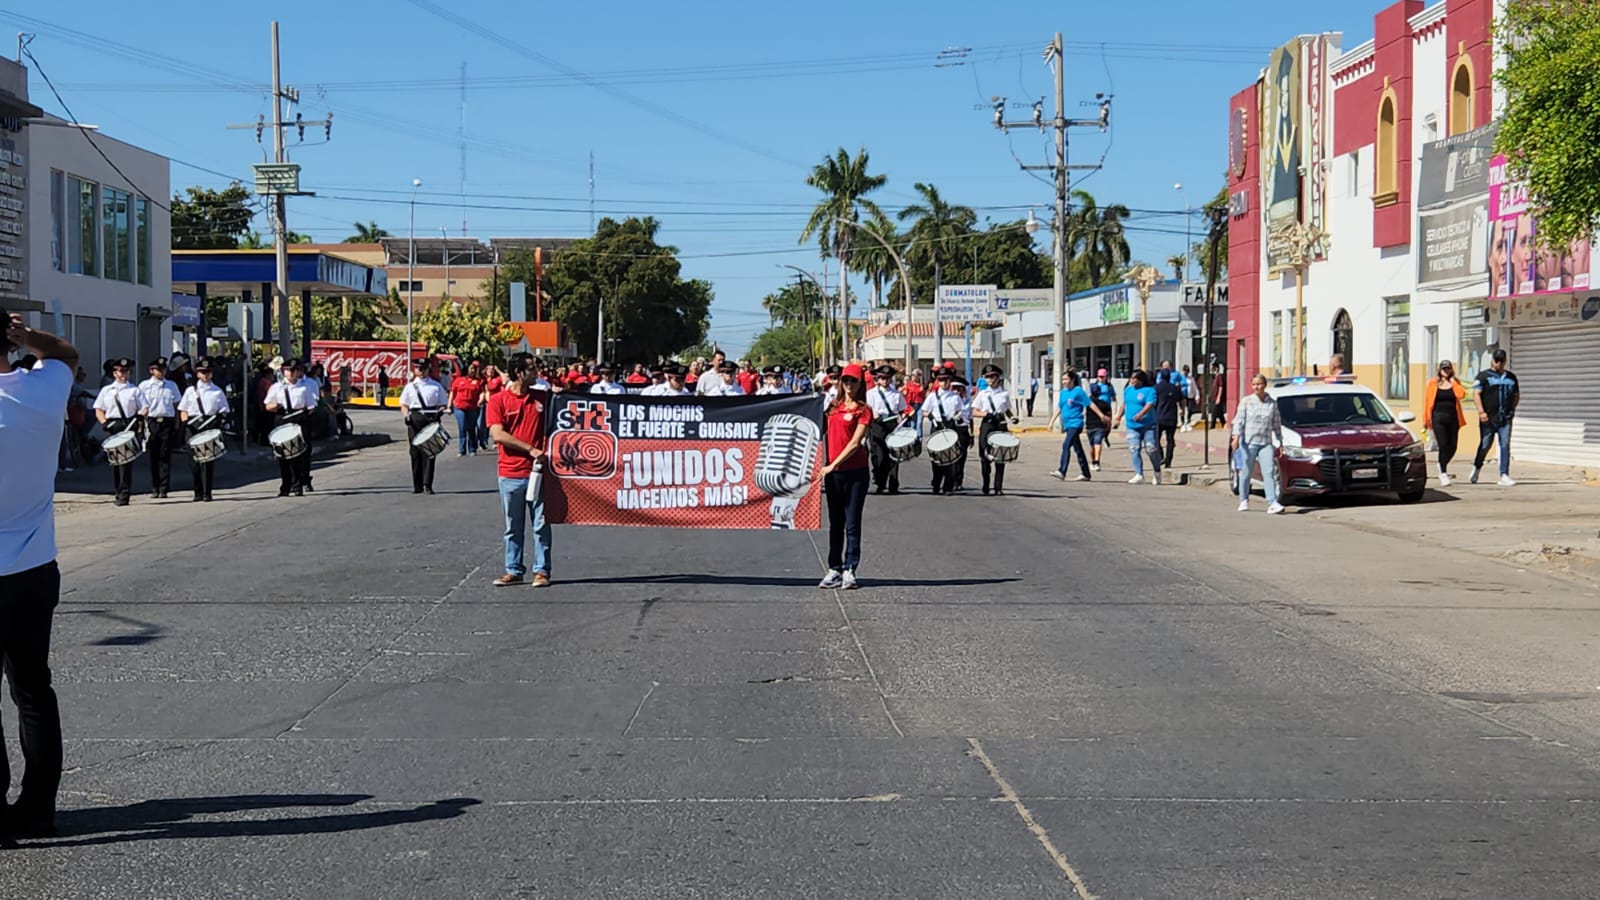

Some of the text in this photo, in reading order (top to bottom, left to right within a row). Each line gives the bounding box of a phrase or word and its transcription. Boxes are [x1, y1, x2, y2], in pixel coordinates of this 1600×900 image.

[1185, 286, 1229, 303] FAM
[619, 403, 704, 422] LOS MOCHIS
[619, 421, 635, 438] EL
[637, 421, 685, 439] FUERTE
[698, 422, 759, 440] GUASAVE
[622, 447, 744, 489] ¡UNIDOS
[616, 482, 749, 510] HACEMOS MÁS!
